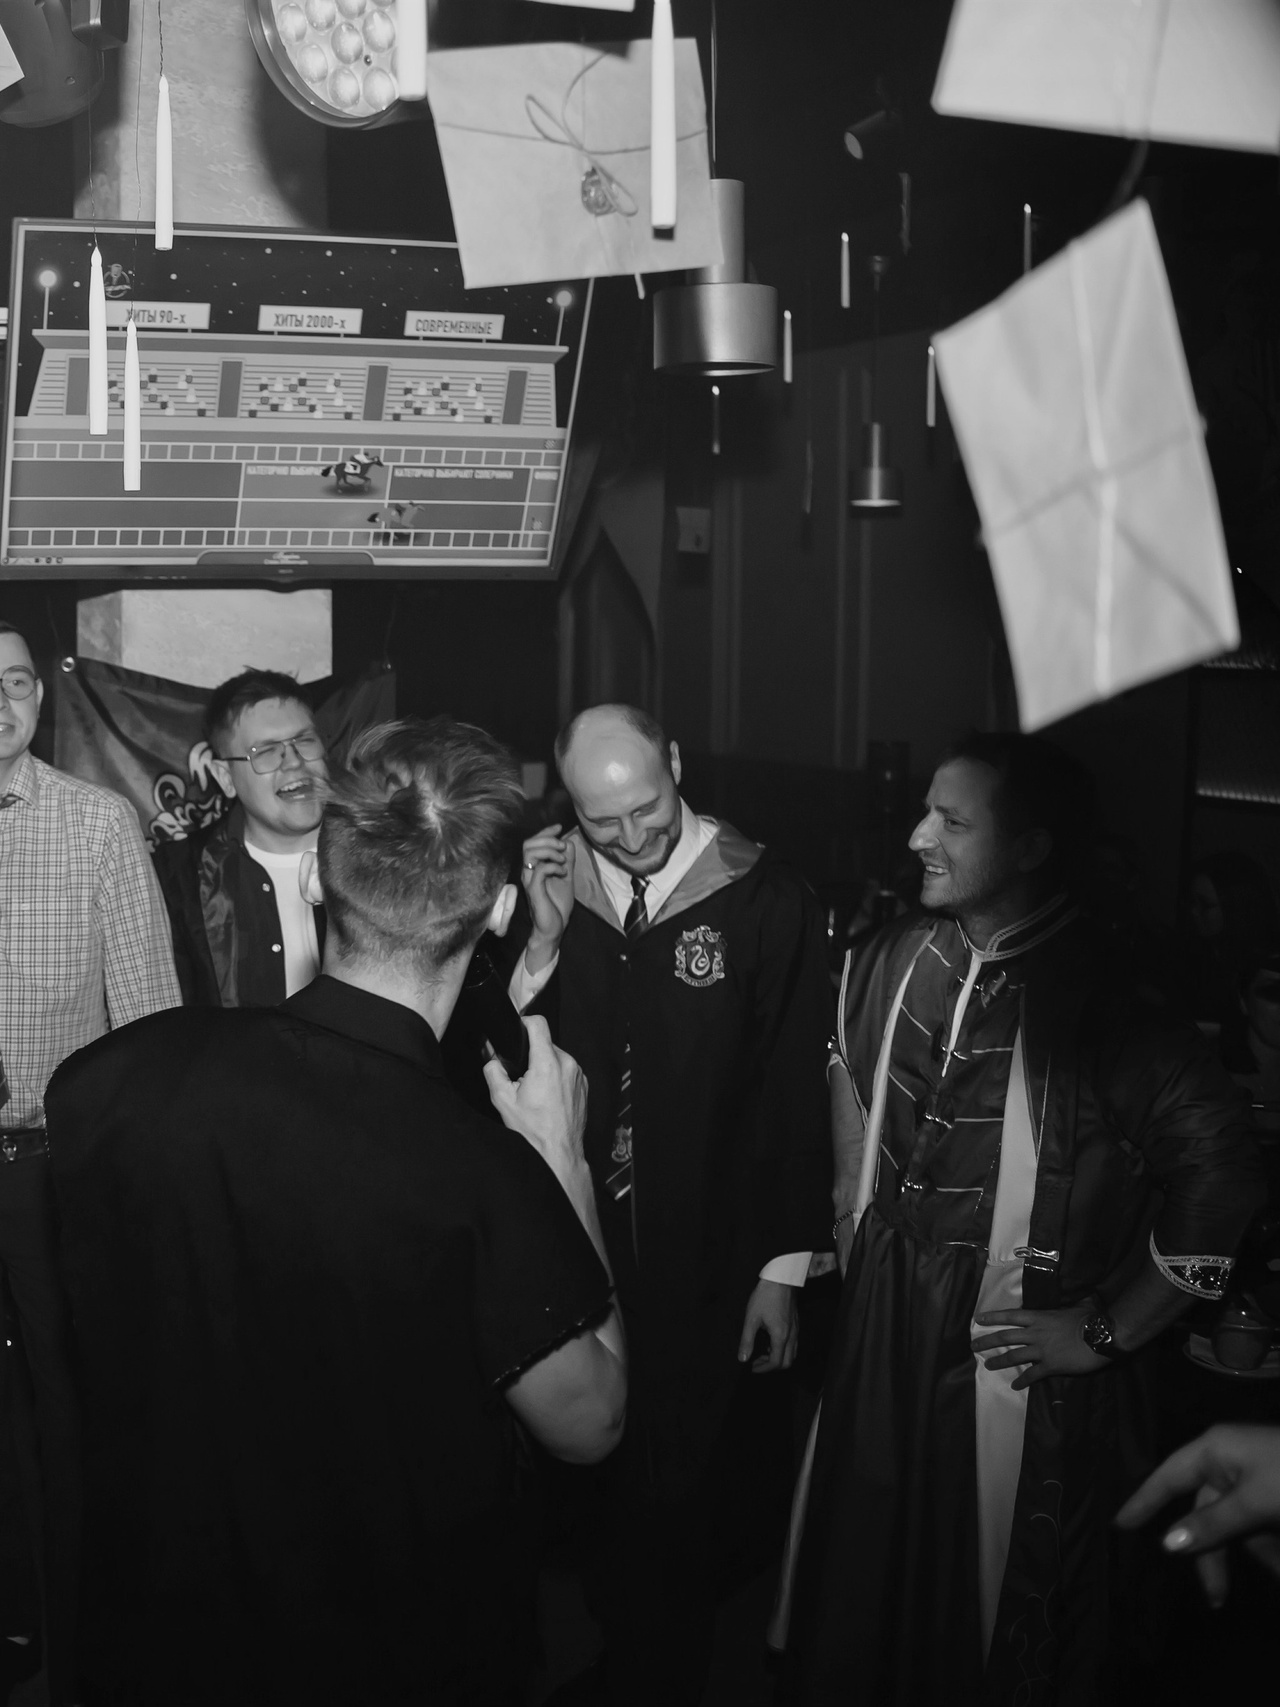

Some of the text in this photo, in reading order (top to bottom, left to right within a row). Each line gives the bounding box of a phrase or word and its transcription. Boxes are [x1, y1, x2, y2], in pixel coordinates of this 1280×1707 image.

[125, 309, 186, 324] ХИТЫ 90-х
[274, 313, 346, 329] ХИТЫ 2000-х
[415, 319, 493, 335] СОВРЕМЕННЫЕ
